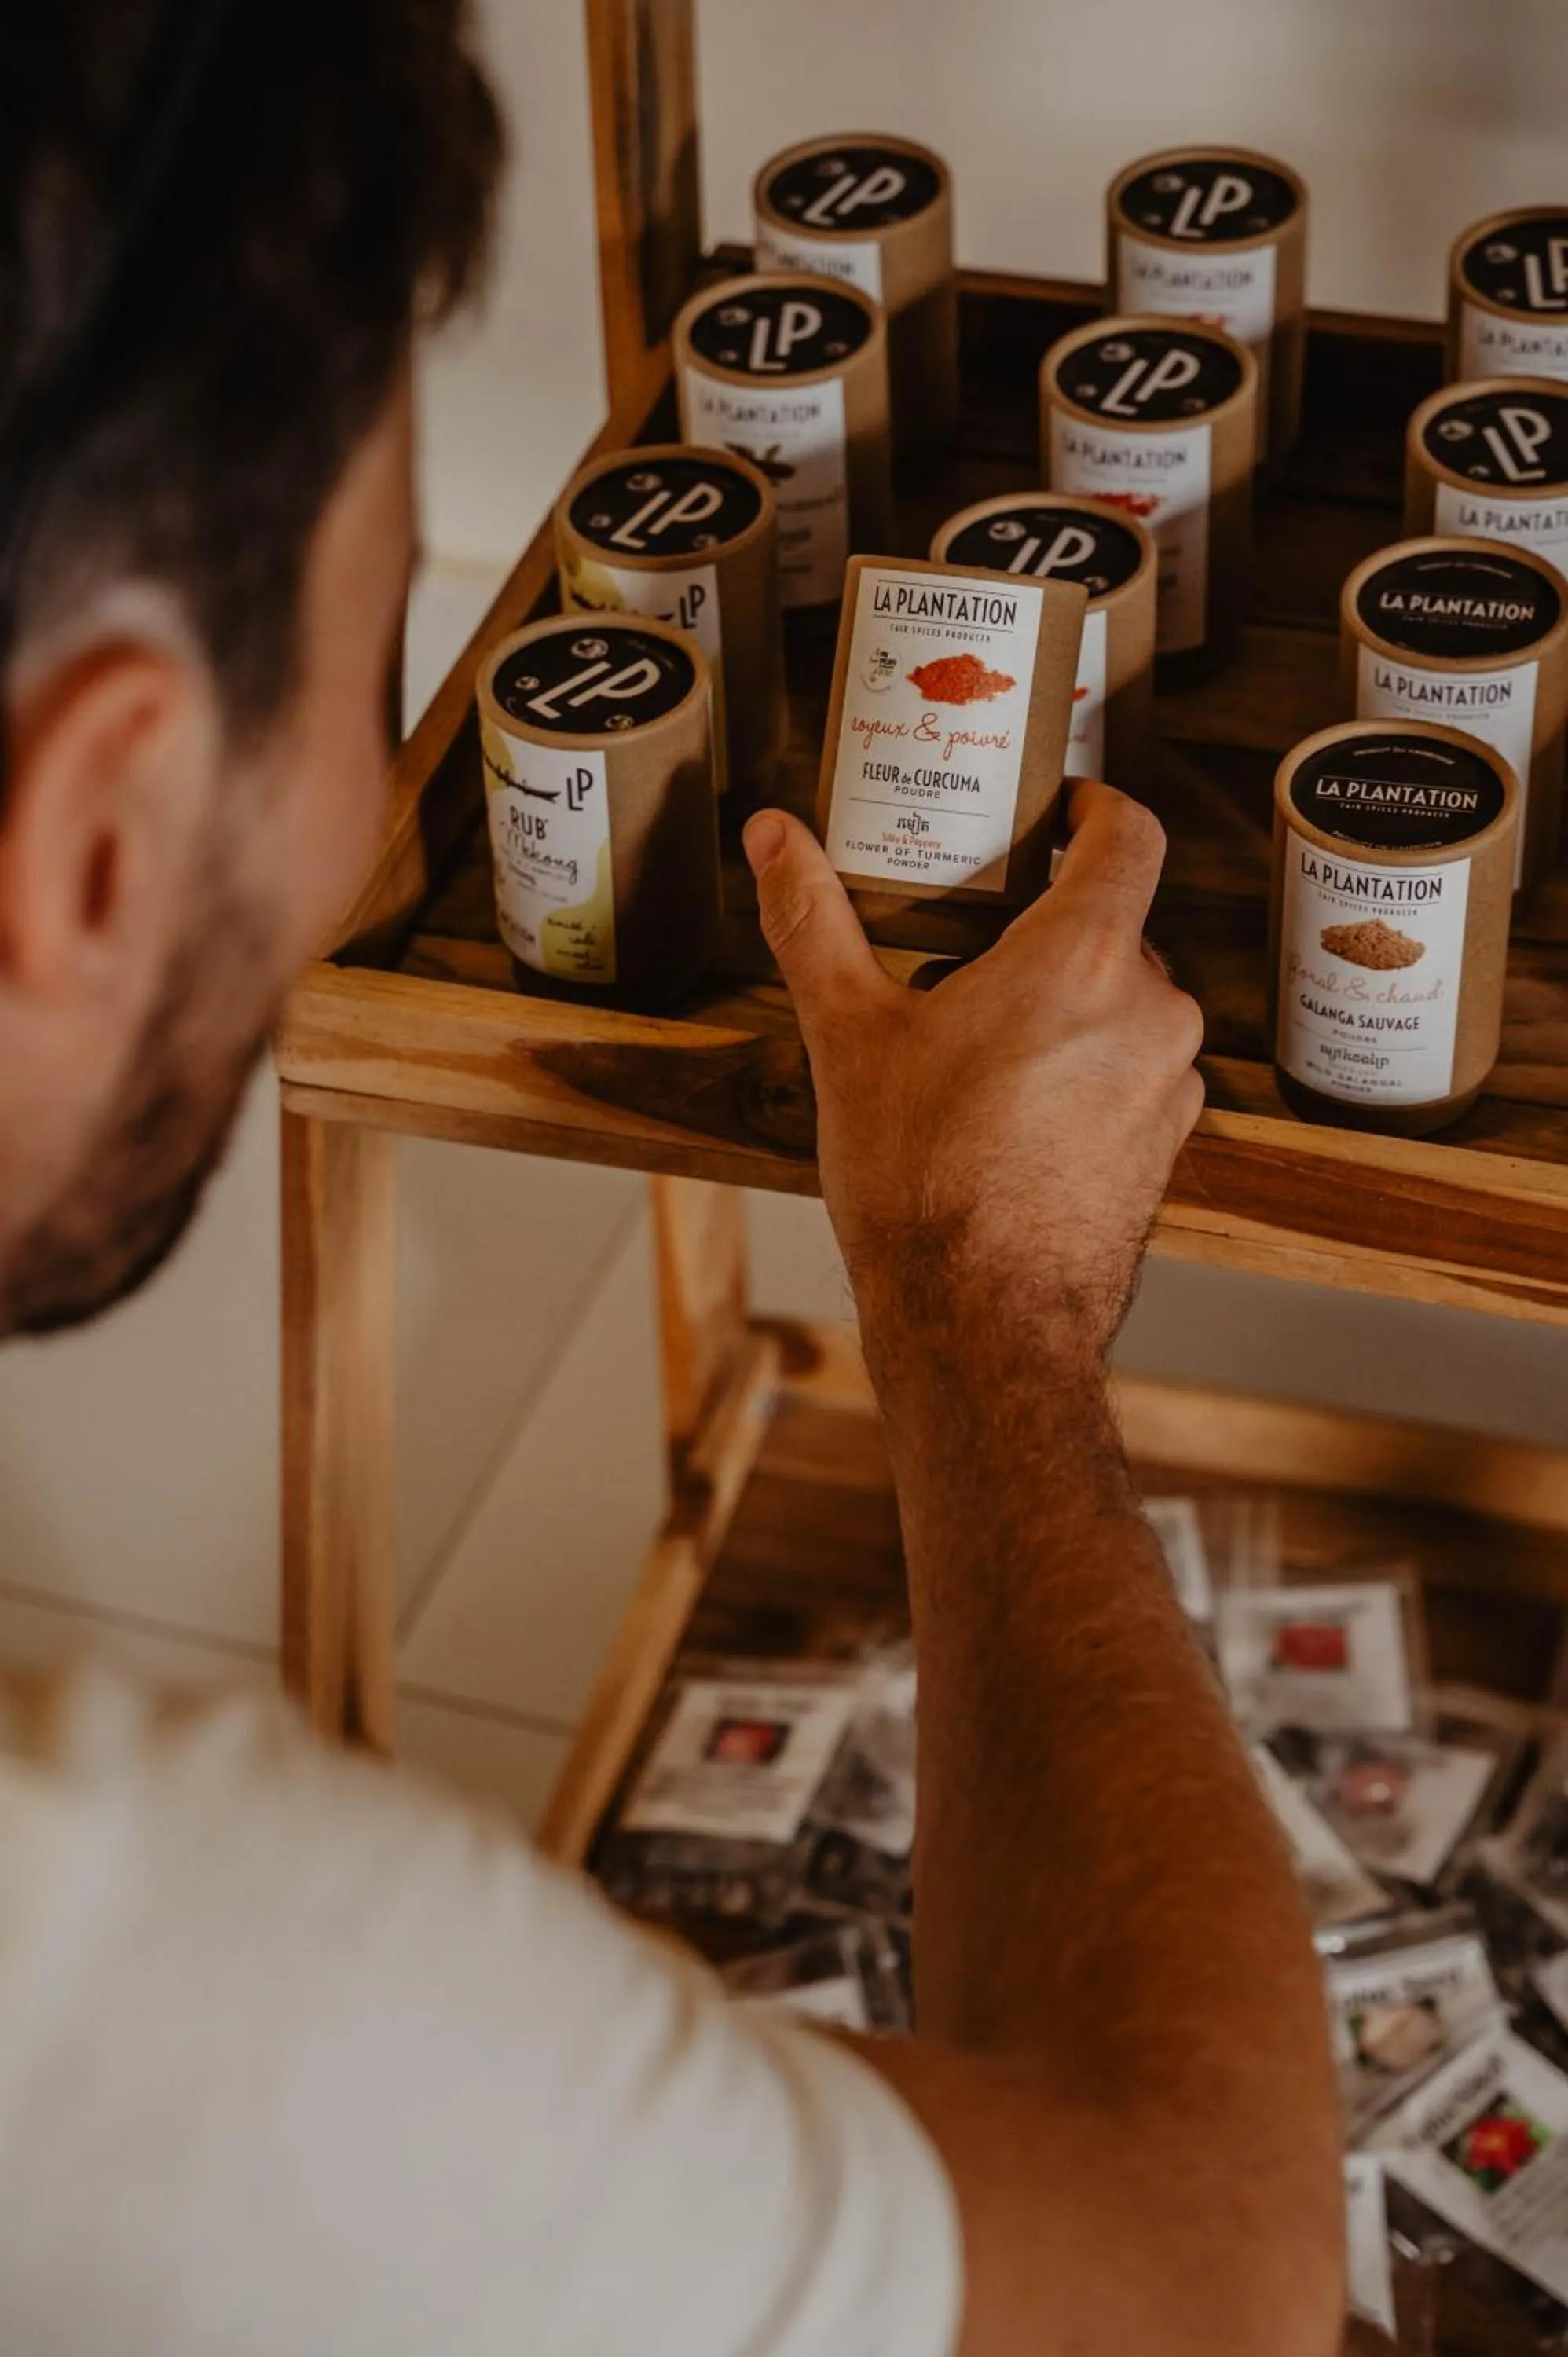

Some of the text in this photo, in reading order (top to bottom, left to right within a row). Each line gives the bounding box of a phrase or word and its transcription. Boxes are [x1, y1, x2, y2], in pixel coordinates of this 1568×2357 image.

[804, 167, 906, 226] LP
[1170, 174, 1254, 238] LP
[749, 302, 822, 371] LP
[1101, 347, 1202, 415] LP
[1481, 408, 1552, 482] LP
[610, 482, 724, 549] LP
[680, 584, 705, 629] LP
[874, 585, 1018, 626] LA PLANTATION
[1380, 592, 1535, 621] LA PLANTATION
[526, 658, 661, 720] LP
[1375, 666, 1513, 706] LA PLANTATION
[913, 713, 941, 742] &
[566, 768, 593, 811] LP
[863, 761, 981, 794] FLEUR de CURCUMA
[894, 786, 941, 799] POUDRE
[1315, 779, 1478, 809] LA PLANTATION
[510, 805, 547, 841] RUB
[845, 840, 982, 867] FLOWER OF TURMERIC
[887, 858, 930, 870] POWDER
[1301, 852, 1443, 901] LA PLANTATION
[1344, 977, 1370, 1003] &
[1299, 993, 1421, 1031] GALANGA SAUVAGE
